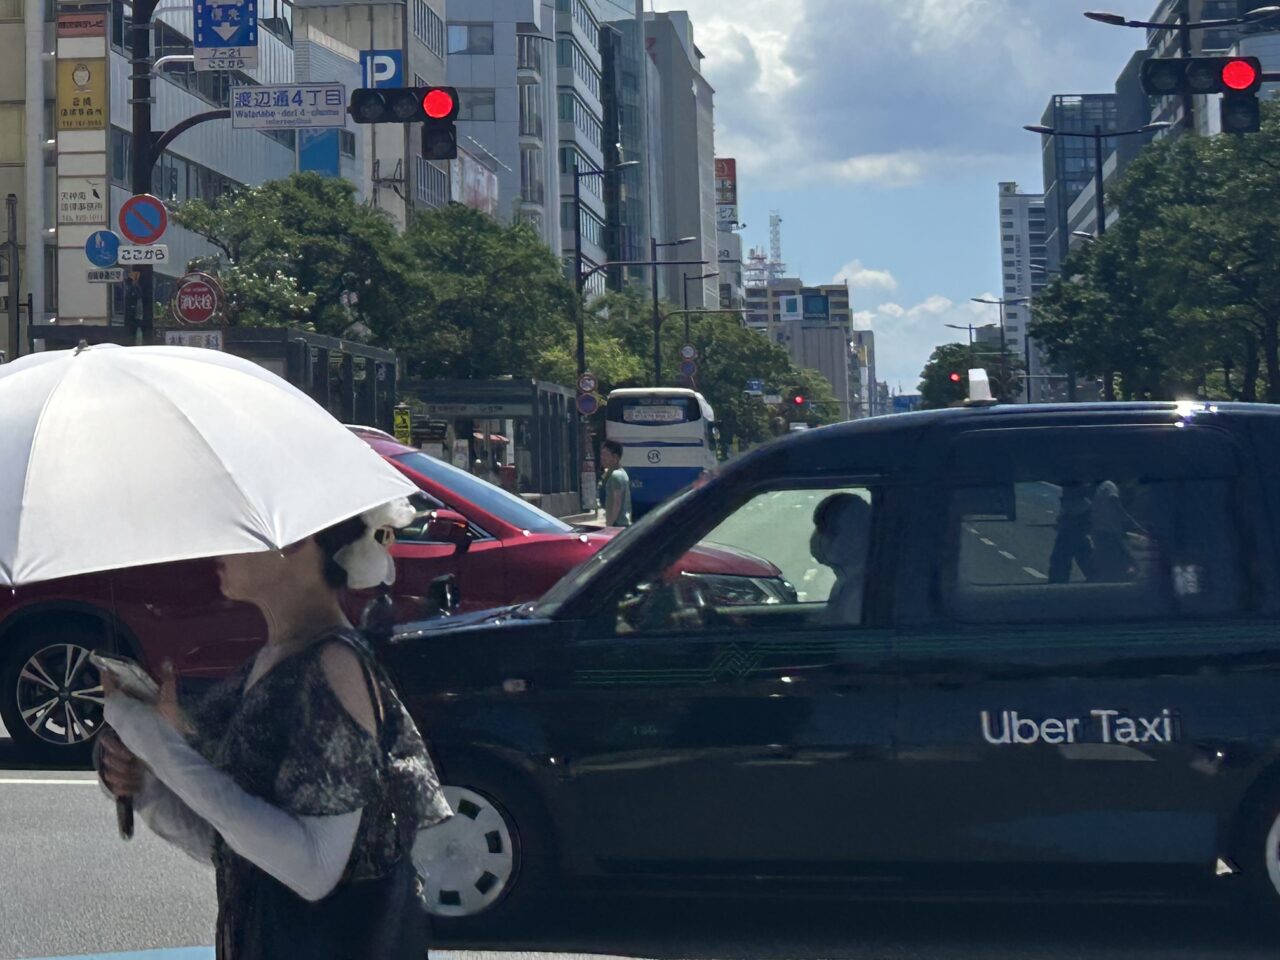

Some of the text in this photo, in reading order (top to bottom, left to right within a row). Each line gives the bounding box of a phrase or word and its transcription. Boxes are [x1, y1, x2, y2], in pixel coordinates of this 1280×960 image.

[366, 55, 396, 89] P
[234, 90, 341, 108] 渡辺通4丁目
[121, 249, 165, 261] ここから
[180, 293, 213, 310] 消火栓
[980, 709, 1171, 744] Uber Taxi
